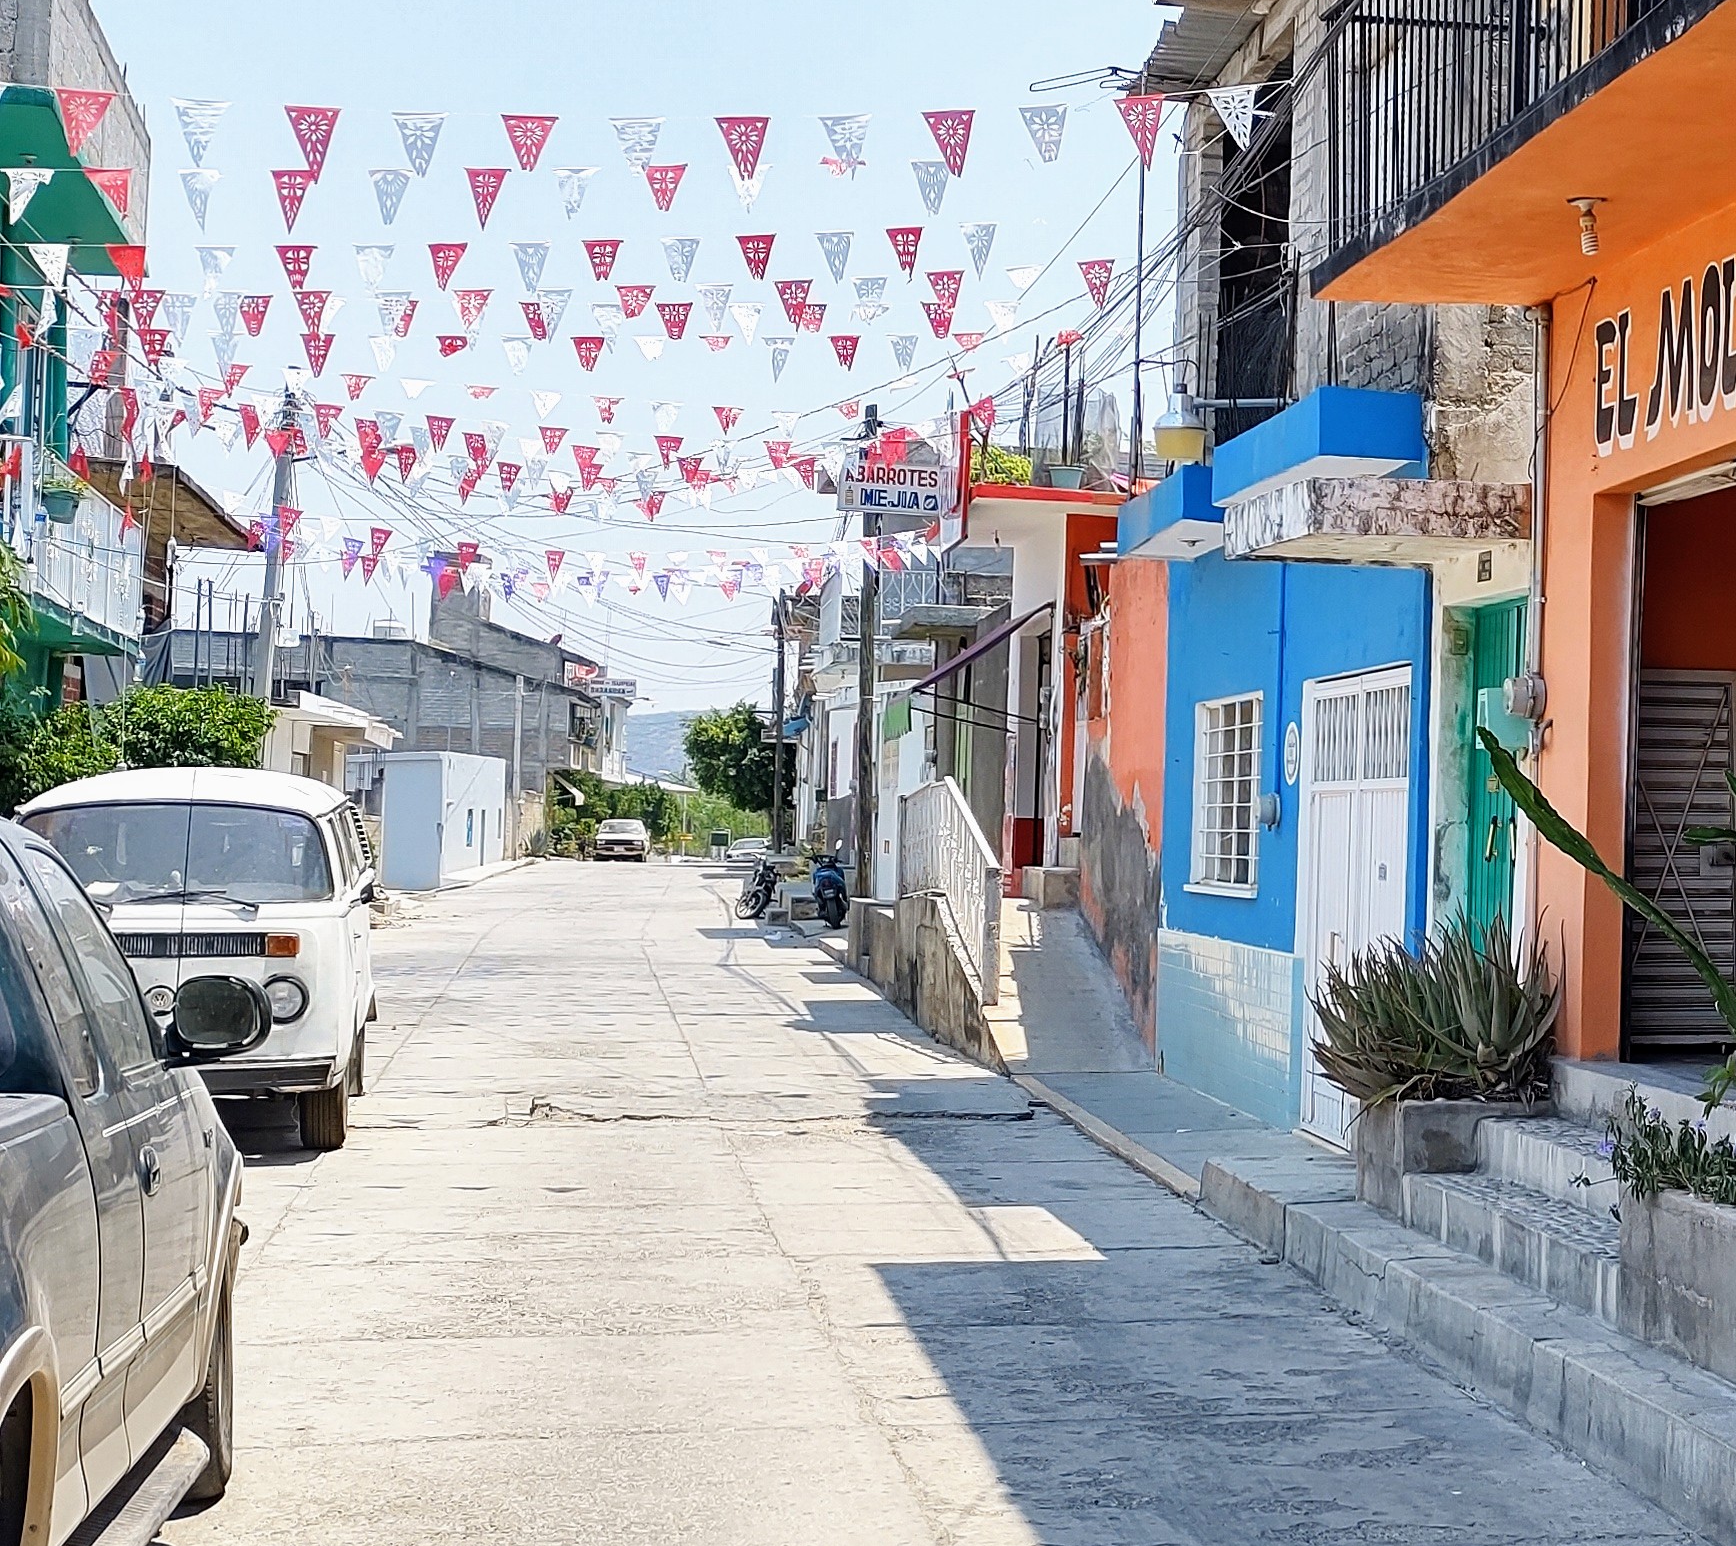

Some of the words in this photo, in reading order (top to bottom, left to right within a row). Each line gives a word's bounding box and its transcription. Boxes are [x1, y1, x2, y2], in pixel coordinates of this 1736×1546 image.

[1594, 311, 1638, 453] EL
[845, 465, 939, 488] ABARROTES
[860, 487, 920, 510] MEJIA
